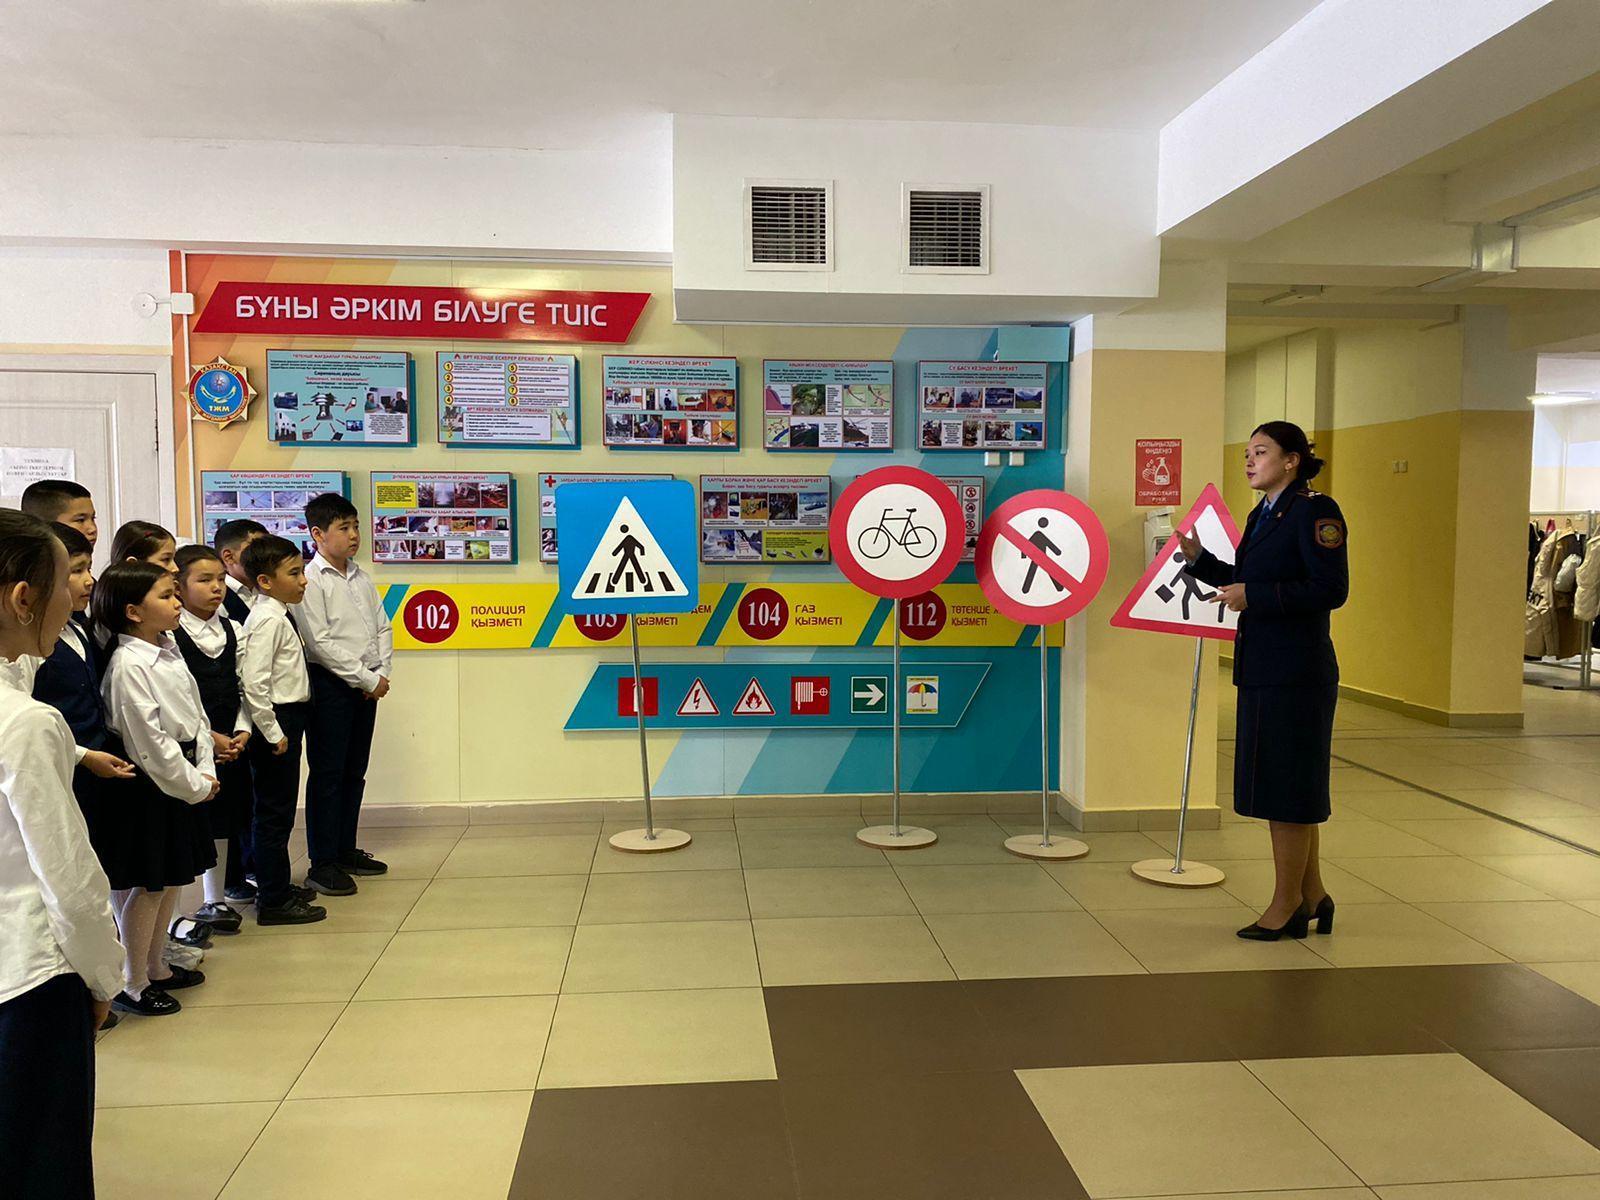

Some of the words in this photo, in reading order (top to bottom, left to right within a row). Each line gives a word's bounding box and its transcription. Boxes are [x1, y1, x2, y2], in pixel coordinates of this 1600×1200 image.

[236, 295, 319, 319] БҰНЫ
[330, 297, 422, 321] ӘРКІМ
[434, 300, 535, 324] БІЛУГЕ
[545, 303, 607, 326] ТИІС
[471, 605, 526, 615] ПОЛИЦИЯ
[748, 601, 781, 626] 104
[795, 604, 816, 614] ГАЗ
[906, 602, 937, 627] 112
[952, 605, 990, 615] ТӨТЕНШЕ
[415, 604, 451, 630] 102
[795, 616, 843, 627] ҚЫЗМЕТІ
[951, 617, 987, 627] ҚЫЗМЕТІ
[471, 617, 522, 629] ҚЫЗМЕТІ
